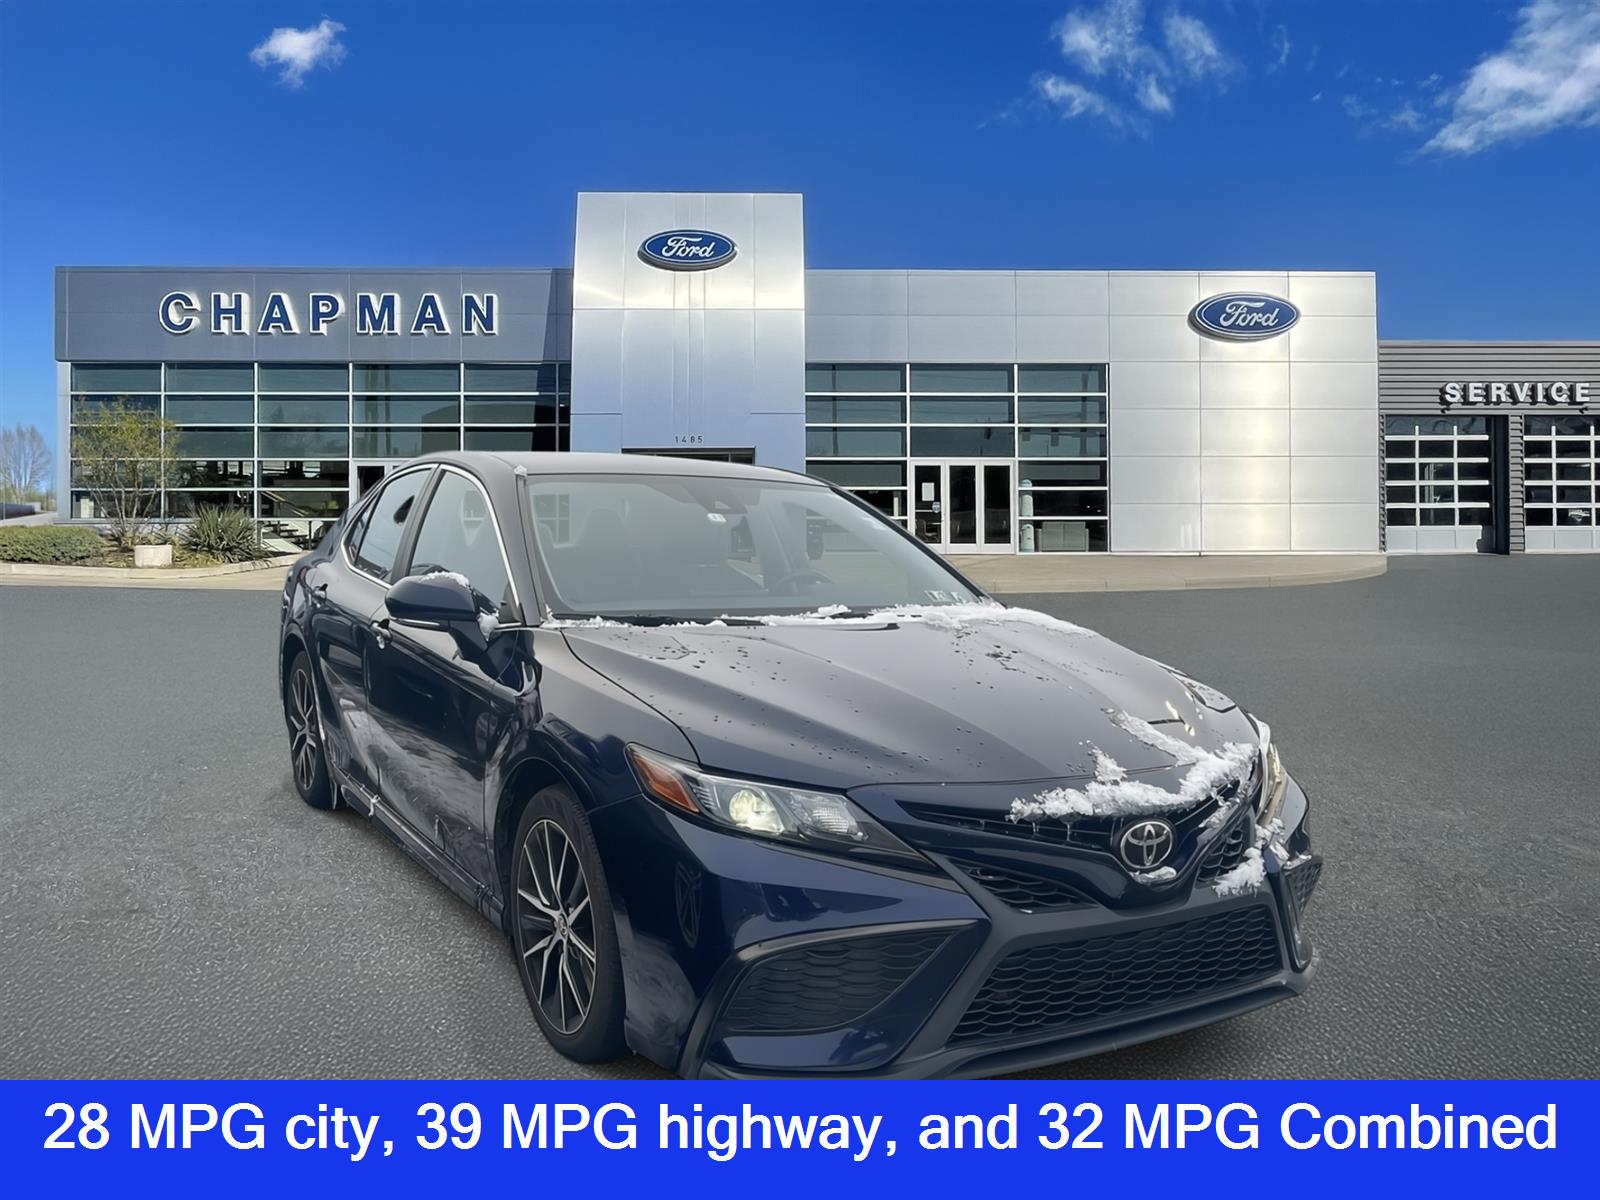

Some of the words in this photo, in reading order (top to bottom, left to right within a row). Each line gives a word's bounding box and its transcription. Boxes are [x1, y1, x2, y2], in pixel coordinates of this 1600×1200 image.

[661, 236, 716, 257] Ford
[159, 291, 500, 336] CHAPMAN
[1219, 301, 1280, 327] Ford
[1443, 382, 1591, 402] SERVICE
[674, 435, 703, 443] 1485
